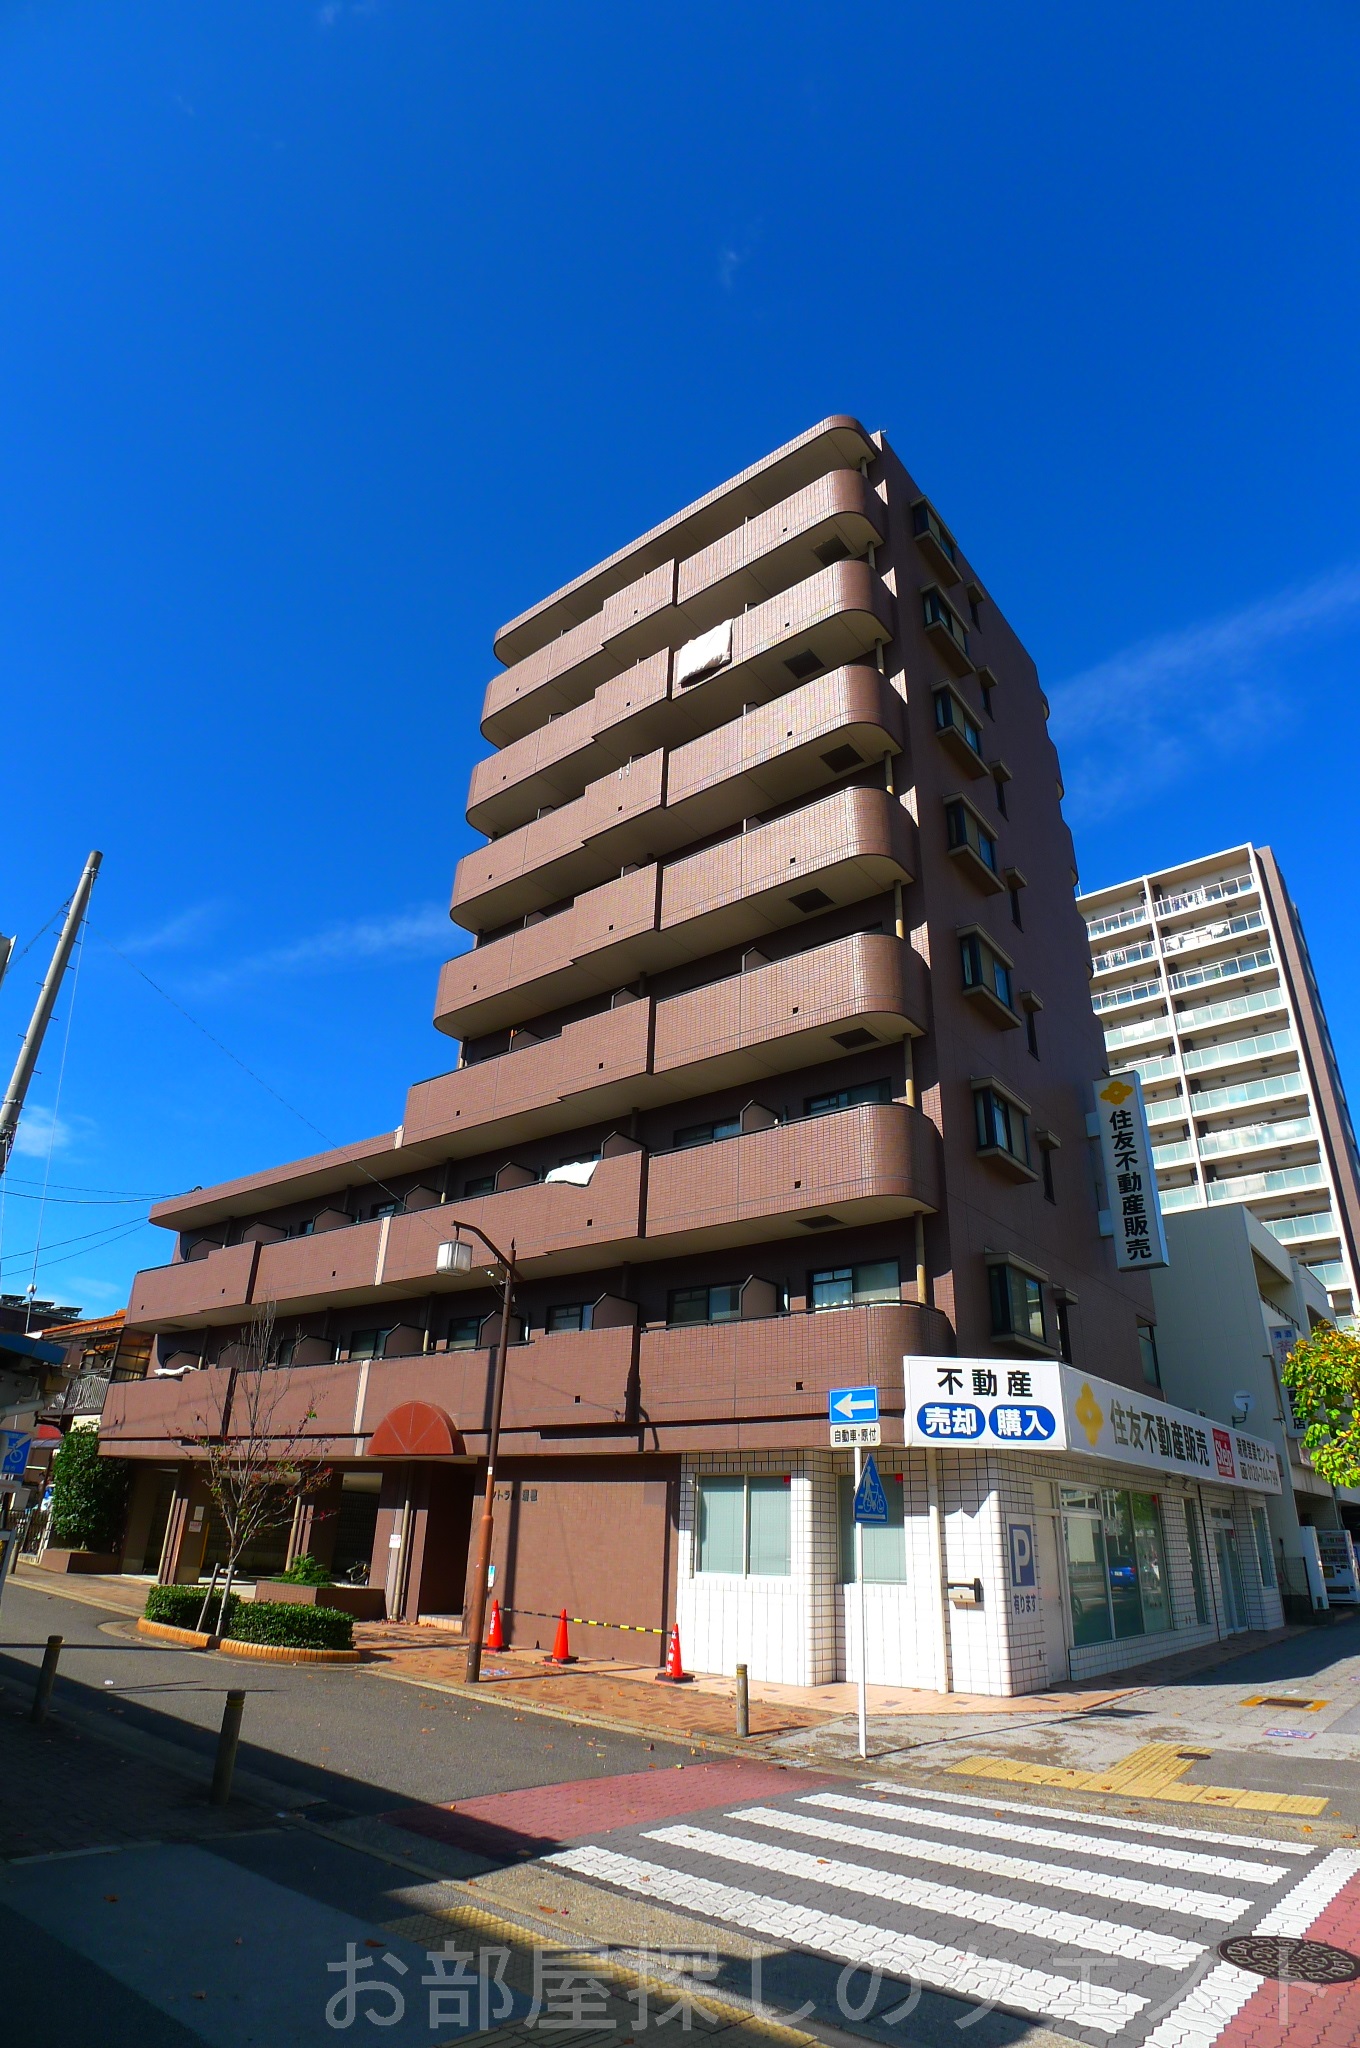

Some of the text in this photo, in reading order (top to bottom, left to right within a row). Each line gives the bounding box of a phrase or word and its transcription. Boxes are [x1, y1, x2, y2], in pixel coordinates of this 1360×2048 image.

[1109, 1110, 1152, 1260] 住友不動産販売
[937, 1367, 1033, 1397] 不動産
[834, 1428, 876, 1443] 自動車・原付
[924, 1406, 1049, 1437] 売却 購入
[1110, 1399, 1210, 1466] 住友不動産販売
[1012, 1529, 1031, 1583] P
[1013, 1594, 1036, 1615] 有ります
